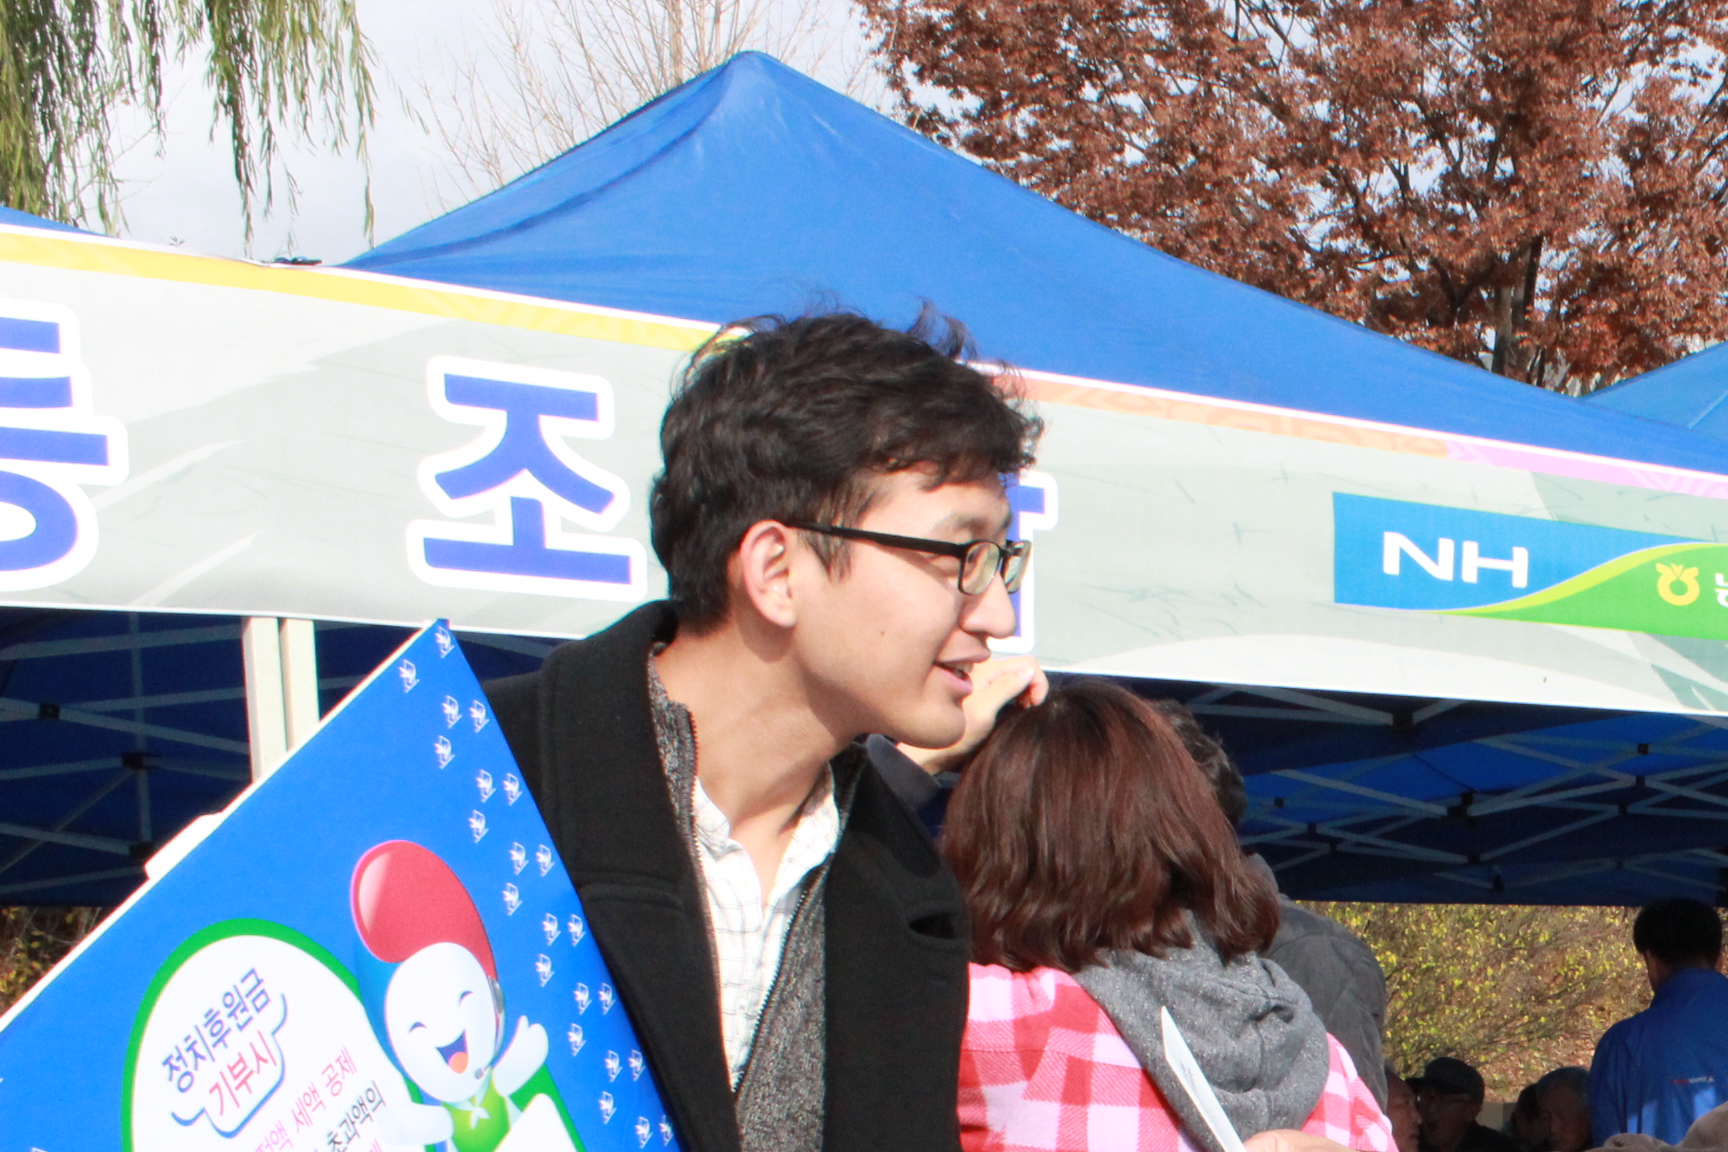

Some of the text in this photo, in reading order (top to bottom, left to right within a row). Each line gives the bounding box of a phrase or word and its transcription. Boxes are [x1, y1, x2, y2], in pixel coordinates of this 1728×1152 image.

[1383, 530, 1529, 588] NH
[161, 967, 271, 1093] 정치후원금
[209, 1030, 278, 1116] 기부시
[292, 1083, 325, 1132] 세액
[322, 1047, 357, 1096] 공제
